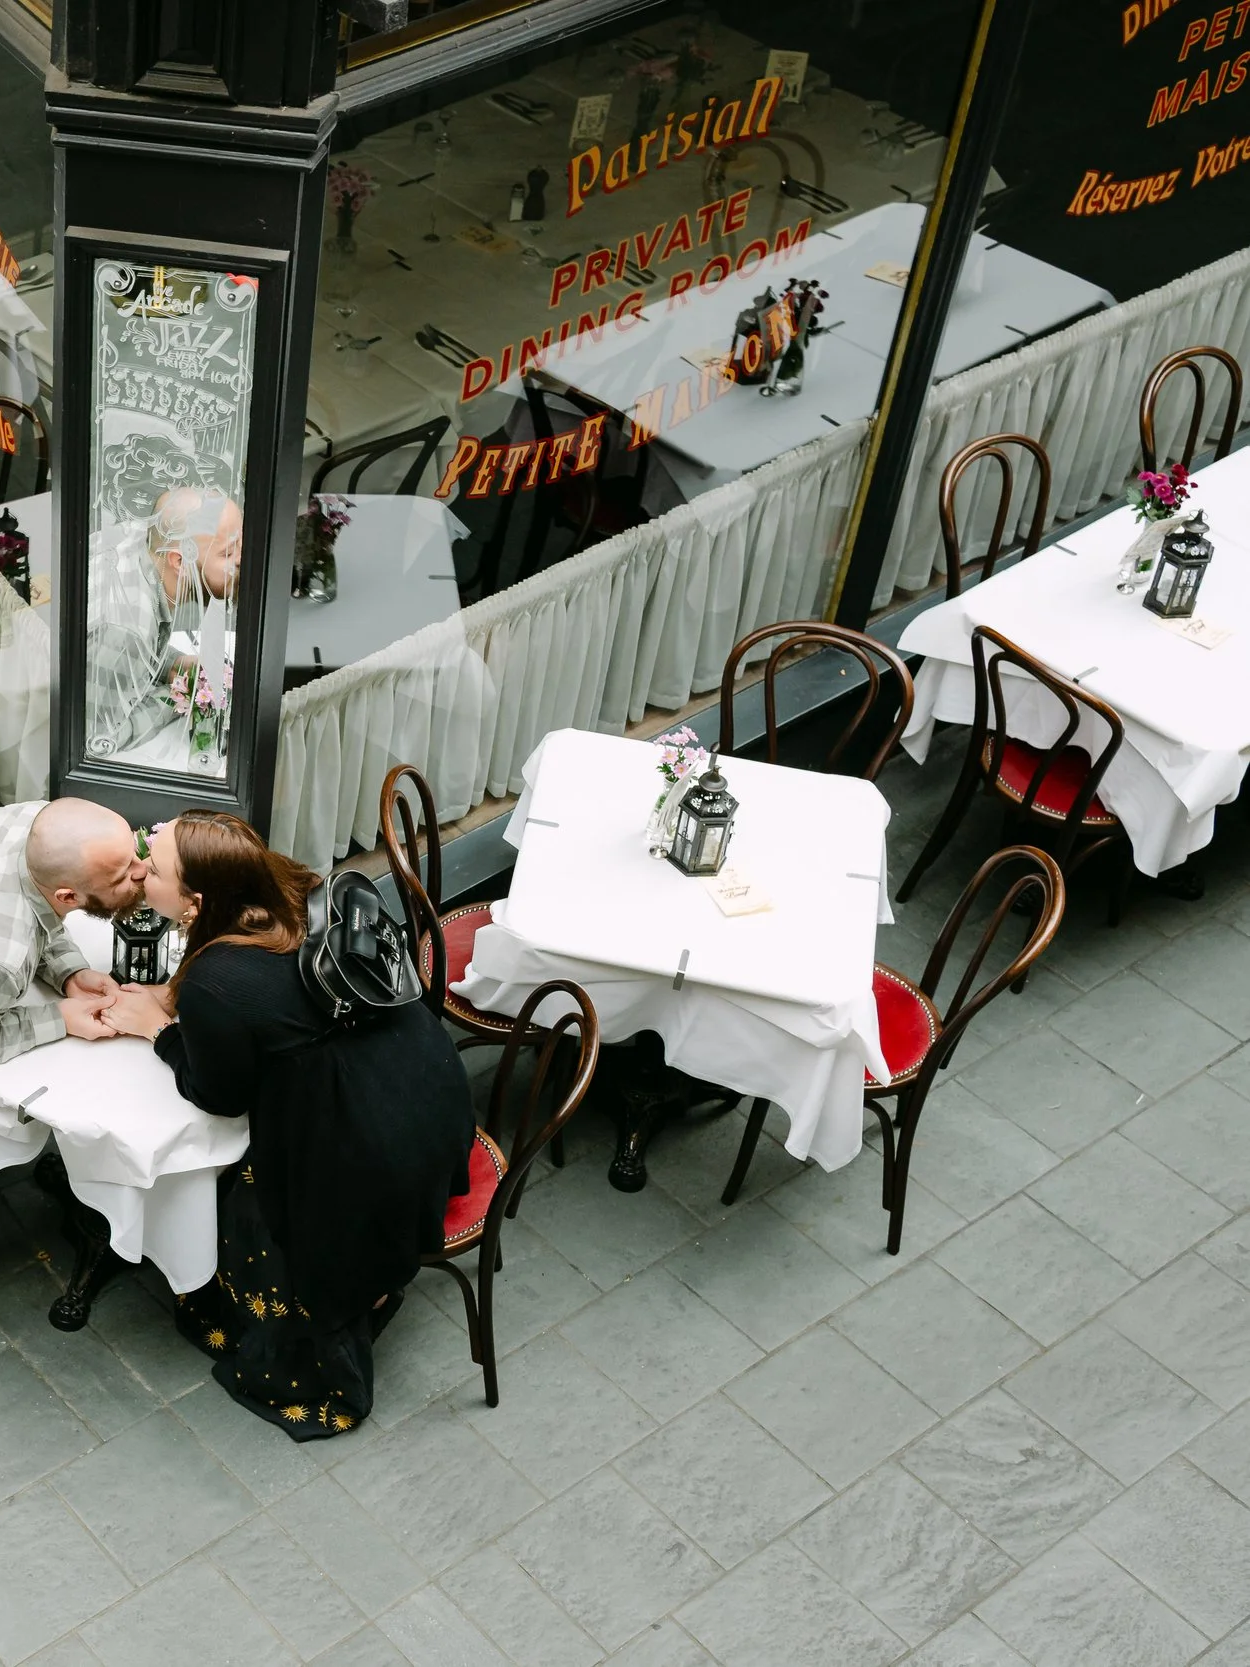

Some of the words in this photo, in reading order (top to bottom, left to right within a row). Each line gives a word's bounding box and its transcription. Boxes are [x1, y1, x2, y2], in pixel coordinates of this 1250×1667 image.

[1065, 168, 1183, 217] Réservez
[548, 188, 752, 309] PRIVATE
[117, 286, 206, 326] Arcade
[460, 292, 646, 404] DINING
[667, 218, 812, 315] ROOM
